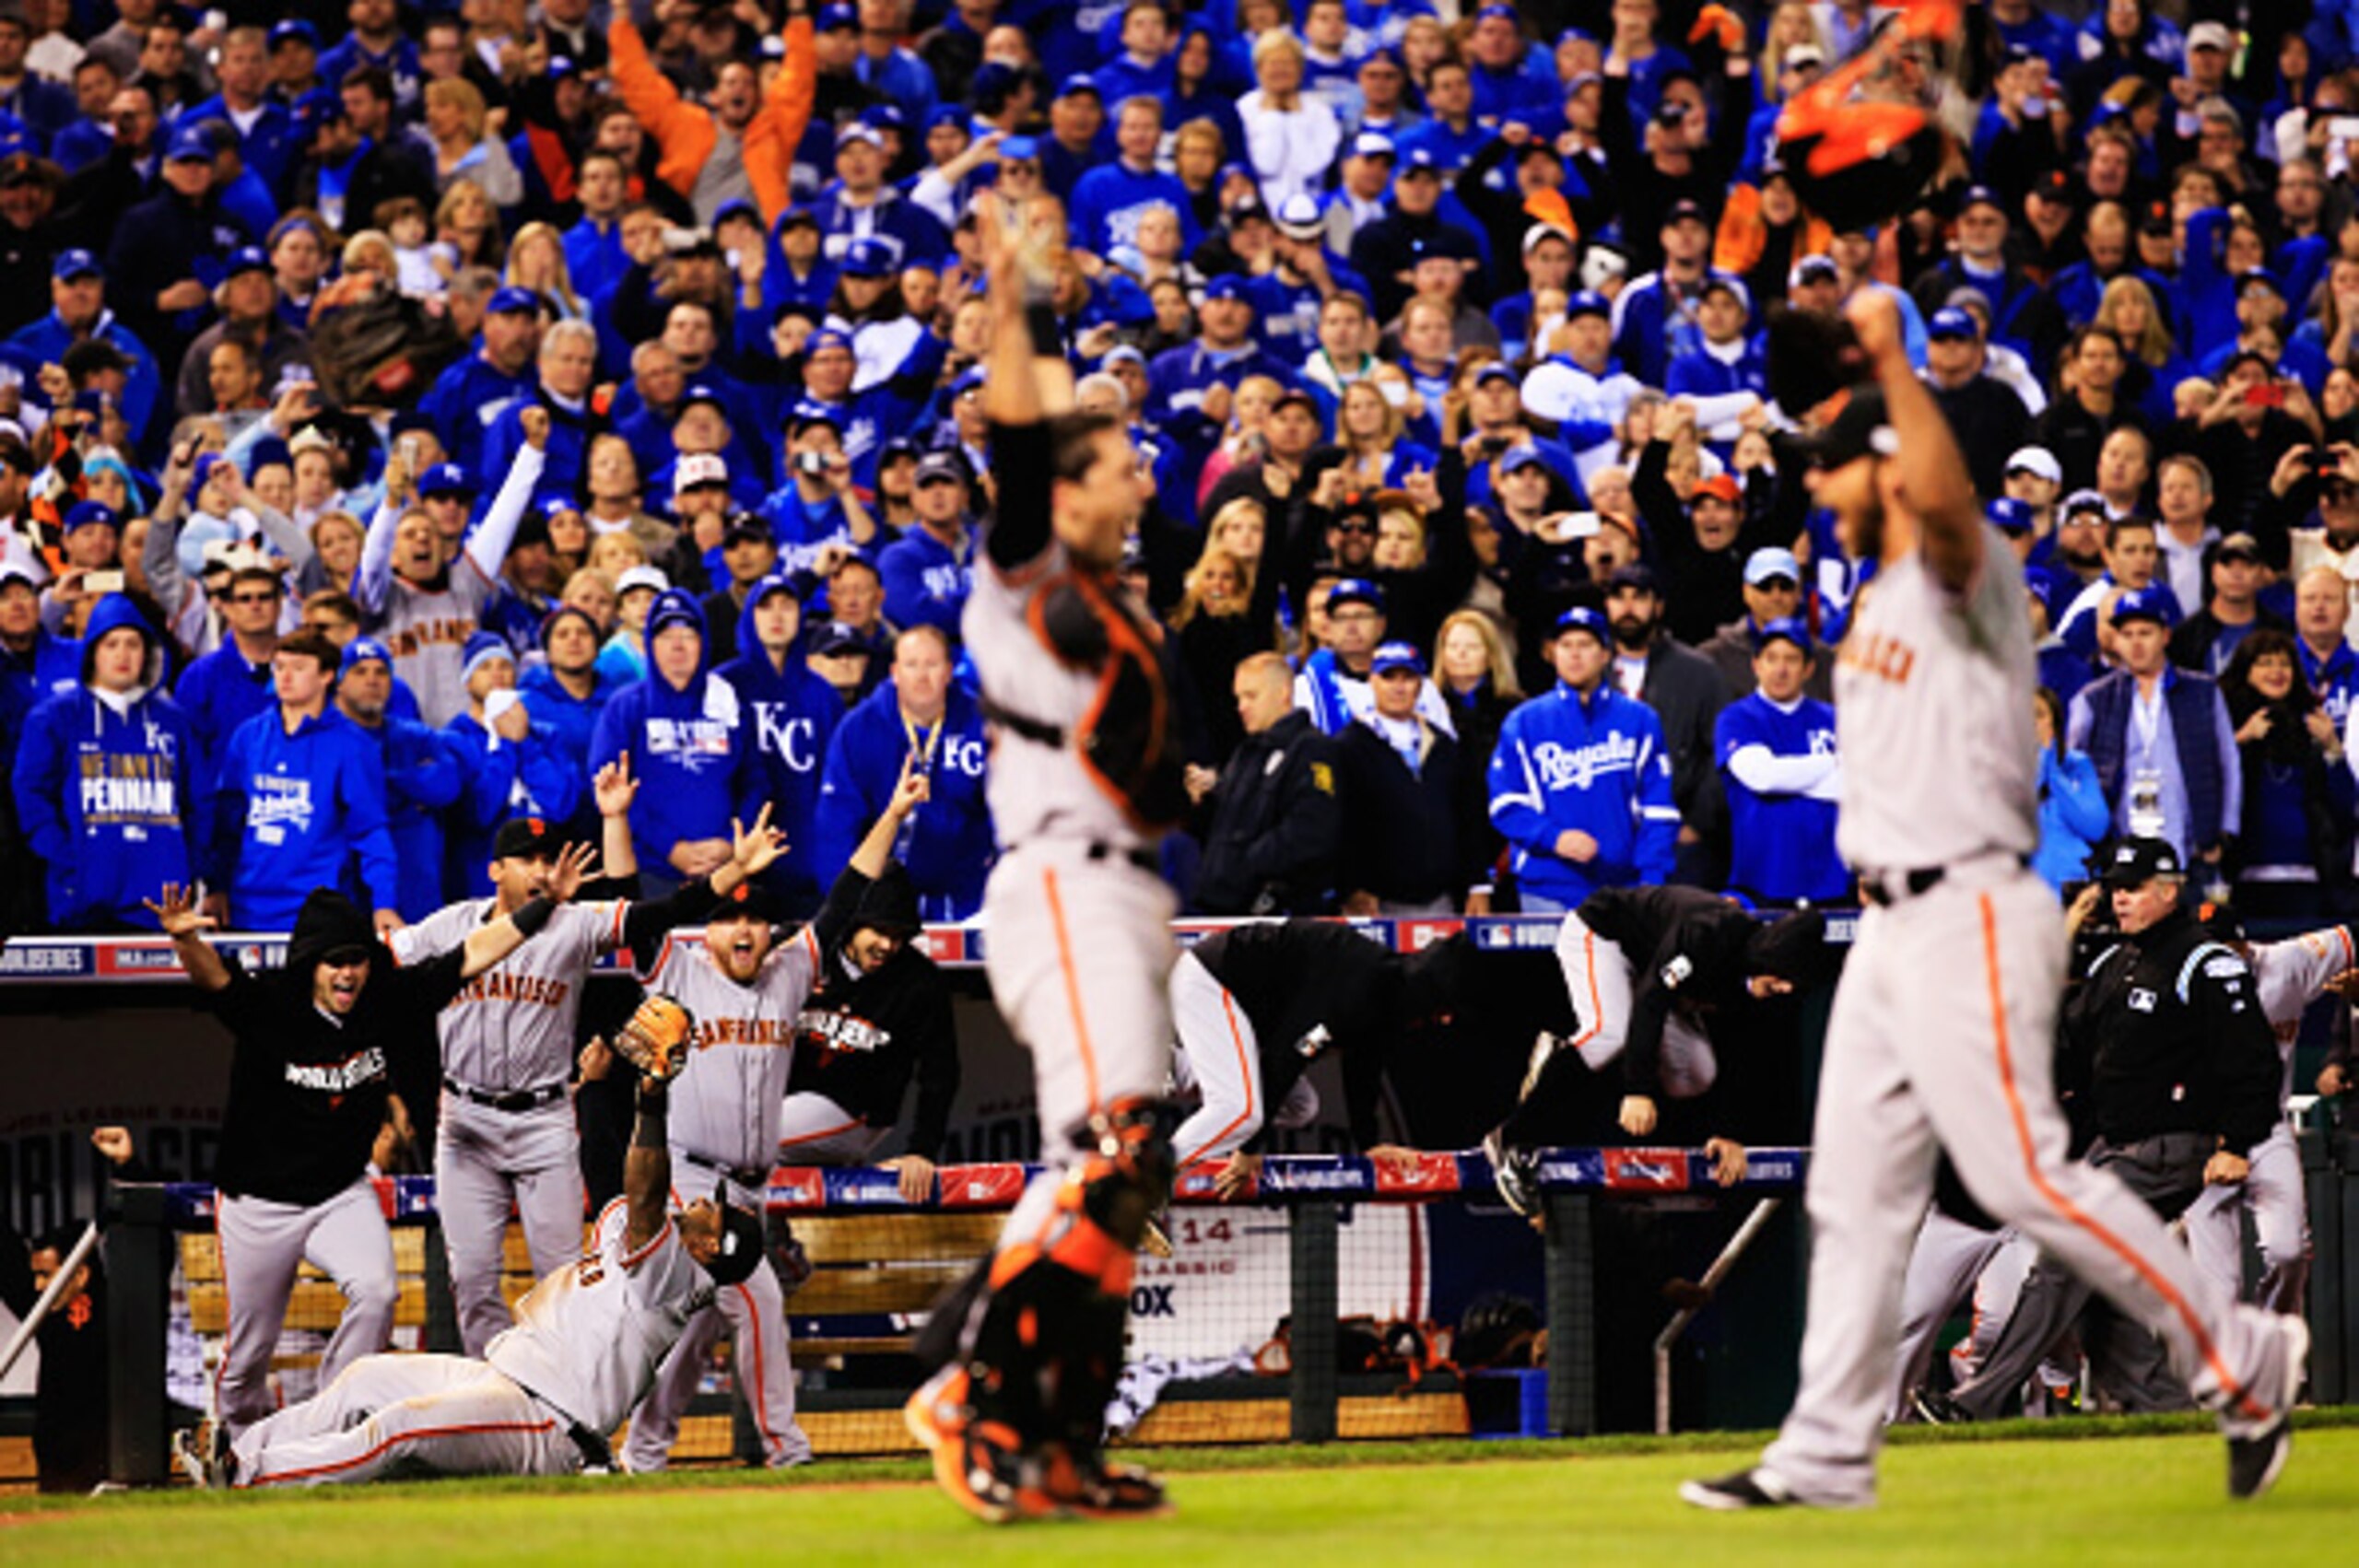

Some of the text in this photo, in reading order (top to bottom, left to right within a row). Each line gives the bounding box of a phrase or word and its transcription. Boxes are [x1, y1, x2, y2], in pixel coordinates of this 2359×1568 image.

[751, 701, 816, 772] KC
[1533, 731, 1637, 790] Royals
[1182, 1218, 1233, 1245] 14
[1140, 1260, 1237, 1277] LASSIC
[1131, 1284, 1176, 1317] OX
